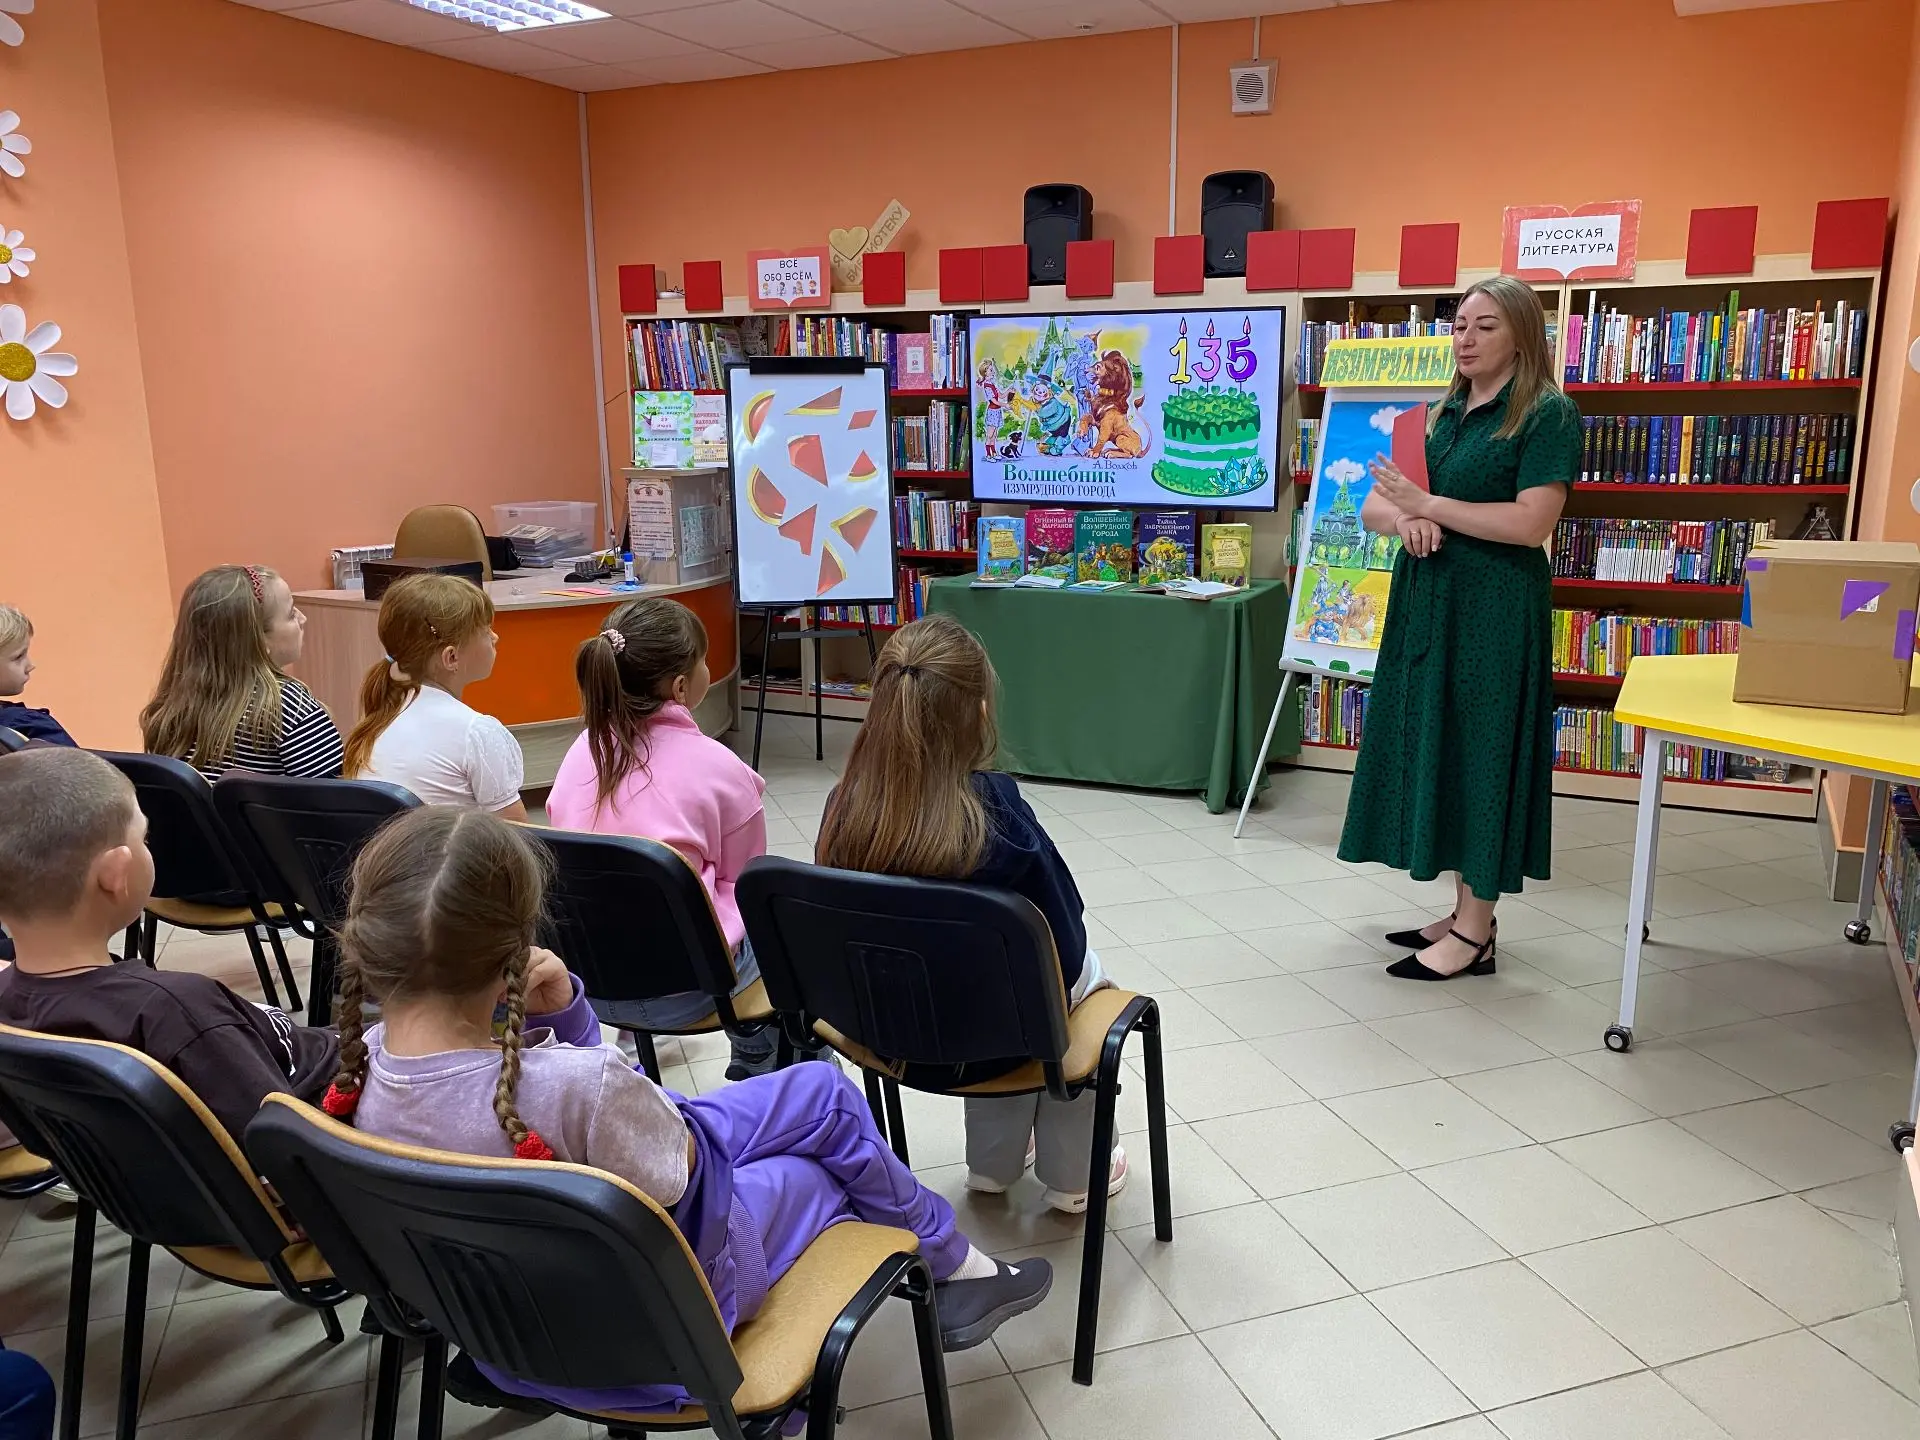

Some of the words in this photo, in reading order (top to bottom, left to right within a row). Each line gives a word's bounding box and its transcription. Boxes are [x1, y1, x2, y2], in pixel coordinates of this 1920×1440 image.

[1535, 227, 1604, 241] РУССКАЯ
[846, 206, 904, 282] БИБИОТЕКУ
[1521, 242, 1615, 257] ЛИТЕРАТУРА
[779, 258, 798, 269] ВСЁ
[833, 253, 844, 268] Я
[764, 272, 782, 282] ОБО
[785, 270, 813, 281] ВСЁМ
[1002, 462, 1116, 484] Волшебник
[1002, 483, 1075, 498] ИЗУМРУДНОГО
[1077, 484, 1117, 498] ГОРОДА
